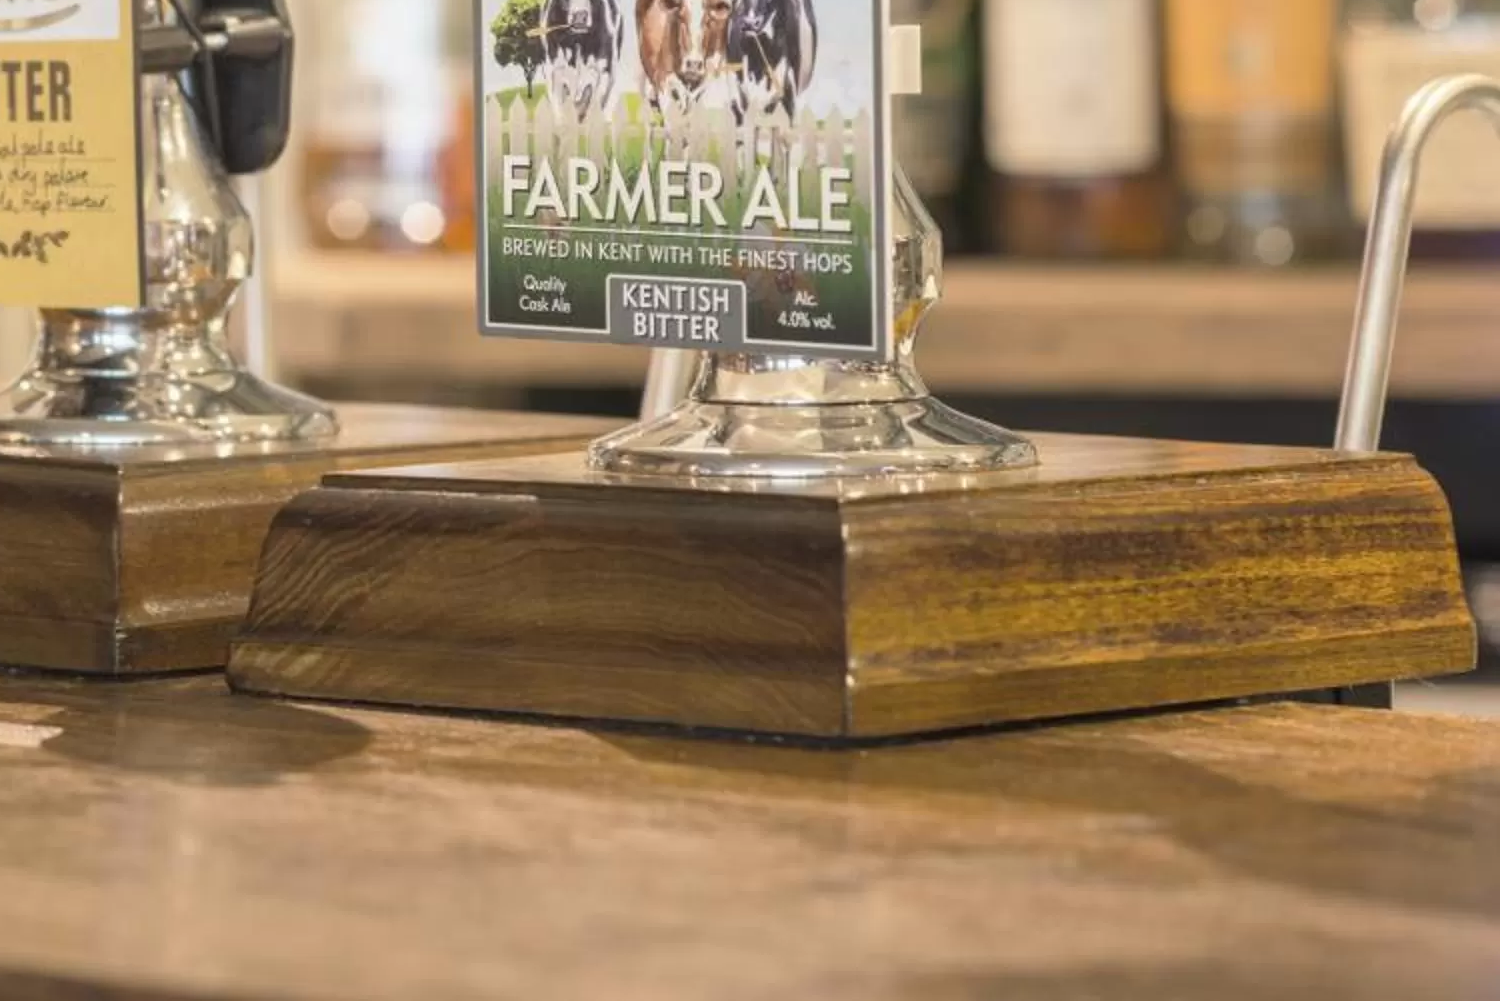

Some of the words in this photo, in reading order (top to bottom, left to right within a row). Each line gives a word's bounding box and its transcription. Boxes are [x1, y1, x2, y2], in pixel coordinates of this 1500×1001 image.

[502, 153, 728, 228] FARMER
[741, 165, 853, 234] ALE
[502, 237, 570, 259] BREWED
[574, 241, 593, 260] IN
[598, 242, 644, 262] KENT
[648, 245, 693, 265] WITH
[699, 248, 734, 267] THE
[737, 249, 799, 271] FINEST
[803, 252, 853, 274] HOPS
[523, 274, 568, 294] Quality
[621, 281, 730, 314] KENTISH
[518, 296, 550, 313] Cask
[632, 312, 721, 343] BITTER
[776, 312, 810, 331] 4.0%
